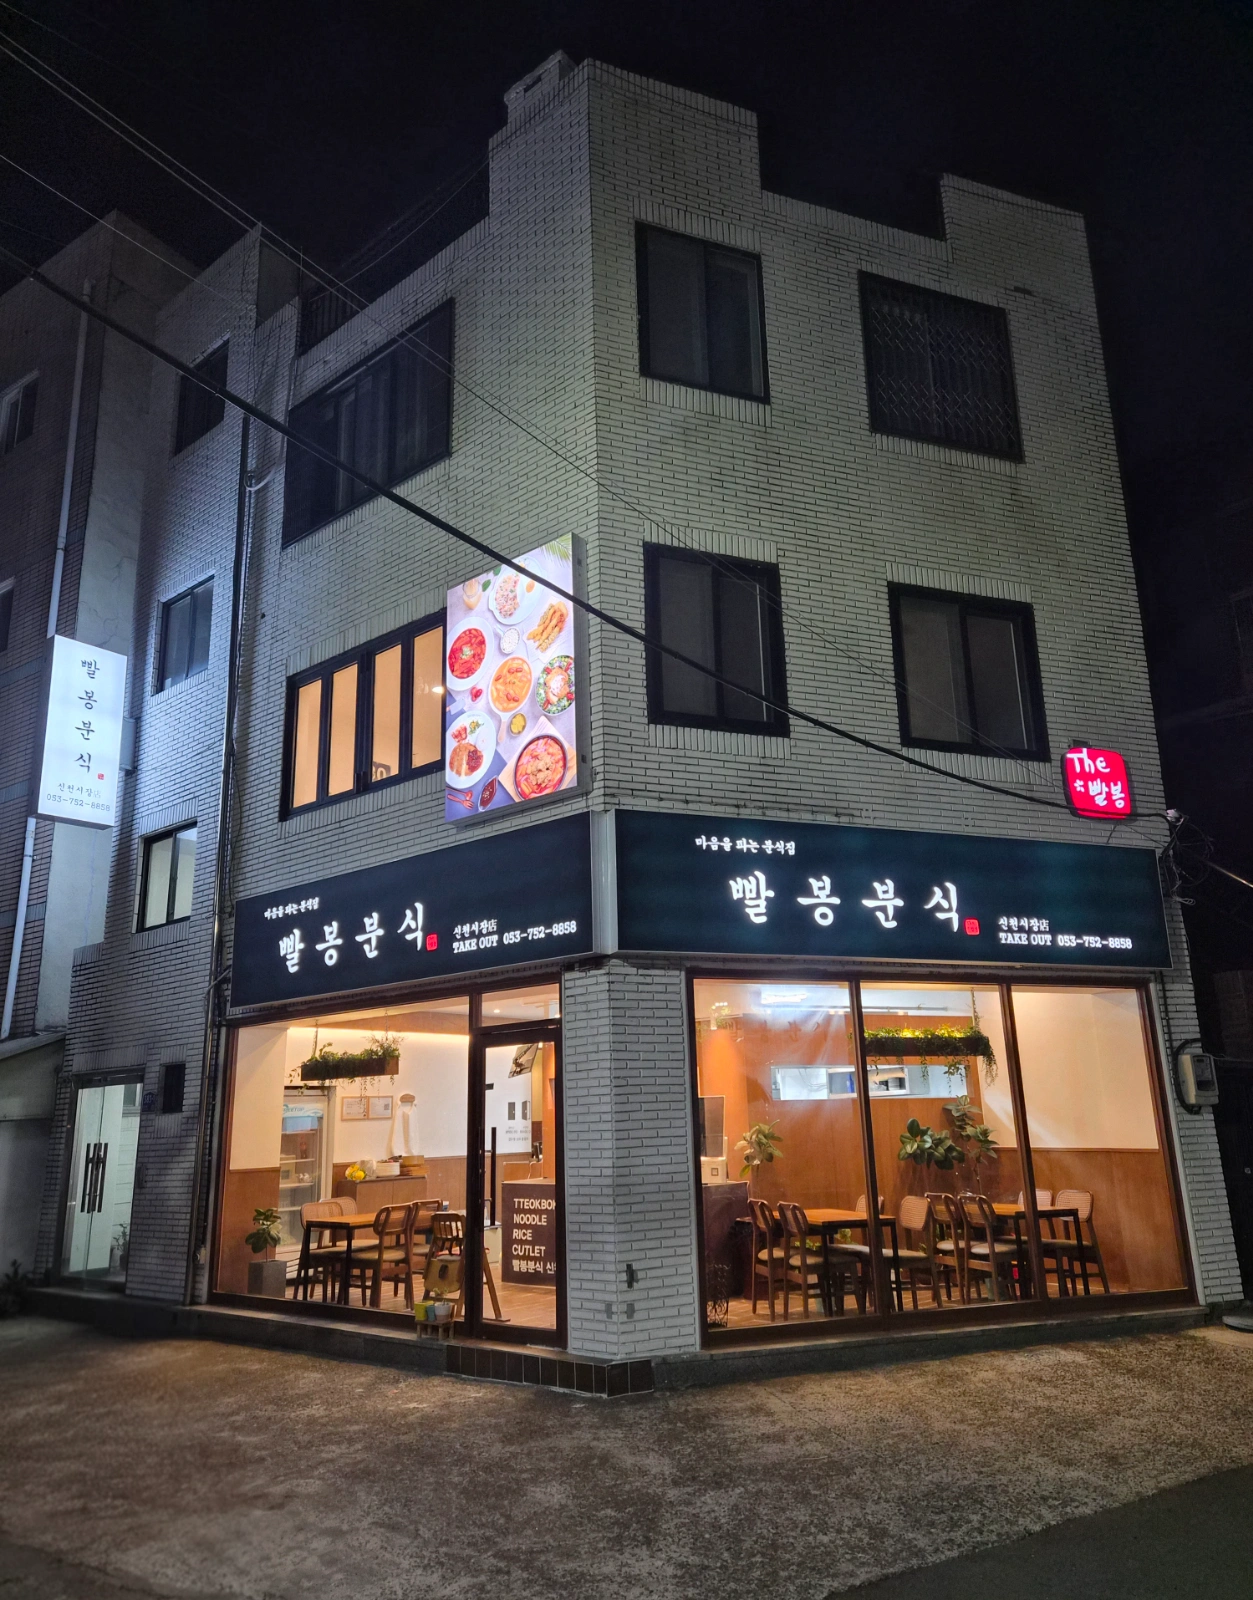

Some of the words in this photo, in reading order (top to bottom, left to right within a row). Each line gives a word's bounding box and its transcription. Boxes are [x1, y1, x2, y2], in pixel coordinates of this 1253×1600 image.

[1066, 748, 1111, 774] The
[46, 793, 111, 812] 053-752-8858
[1088, 778, 1125, 809] 빨봉
[694, 835, 733, 852] 마음을
[736, 838, 760, 854] 파는
[761, 840, 796, 856] 분식집
[264, 905, 284, 920] 마음을
[452, 938, 478, 954] TAKE
[479, 934, 499, 950] OUT
[502, 920, 577, 945] 053-752-8858
[1000, 932, 1028, 945] TAKE
[1031, 934, 1052, 946] OUT
[1057, 935, 1133, 950] 053-752-8858
[514, 1214, 548, 1226] NOODLE
[512, 1228, 532, 1240] RICE
[512, 1244, 546, 1257] CUTLET
[512, 1259, 544, 1274] 빨봉분식
[546, 1261, 557, 1274] 신
